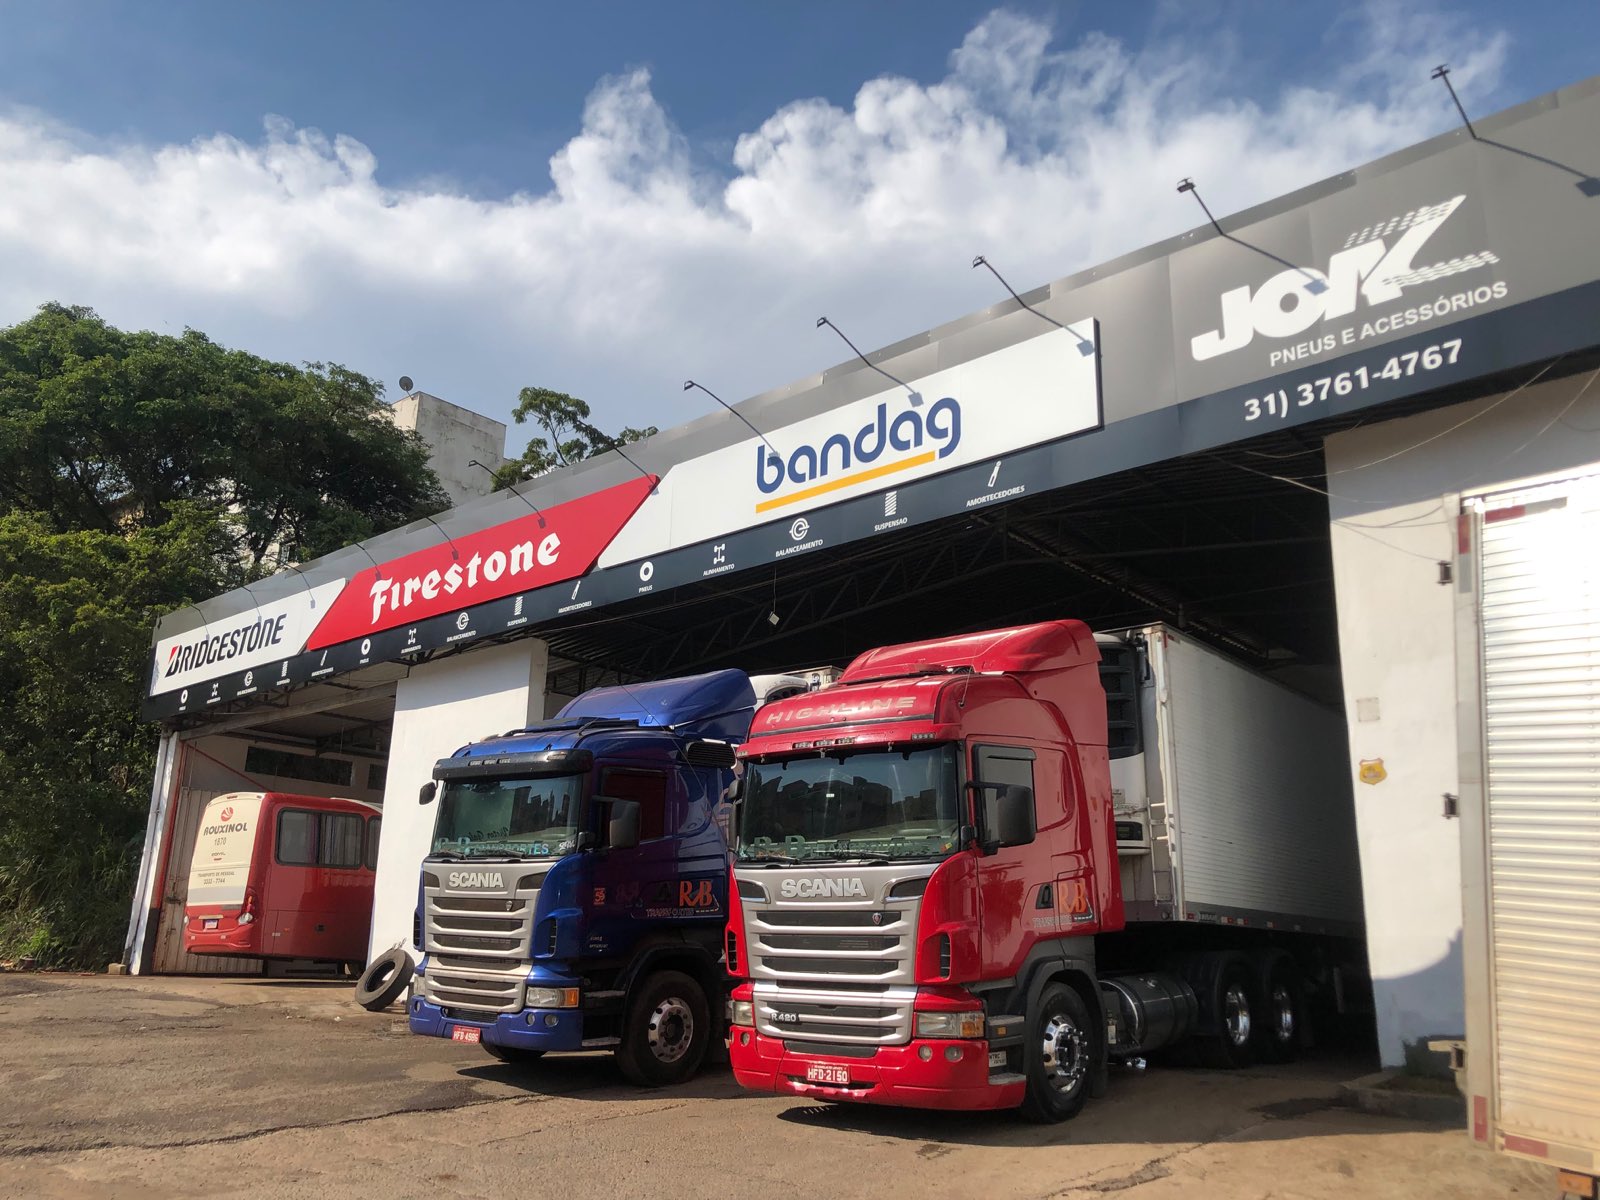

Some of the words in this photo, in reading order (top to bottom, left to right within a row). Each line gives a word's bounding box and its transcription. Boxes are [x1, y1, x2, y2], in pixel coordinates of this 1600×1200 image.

[1269, 333, 1336, 367] PNEUS
[1341, 327, 1356, 346] E
[1360, 281, 1508, 340] ACESSÓRIOS
[1244, 390, 1289, 420] 31)
[1297, 338, 1463, 406] 3761-4767
[757, 397, 961, 494] bandag
[966, 485, 1025, 508] AMORTECEDORES
[775, 539, 823, 558] BALANCEAMENTO
[369, 532, 561, 625] Firestone
[703, 563, 735, 577] ALINHAMENTO
[638, 584, 653, 593] PNEUS
[165, 613, 287, 678] BRIDGESTONE
[766, 696, 917, 724] HIGHLINE
[203, 822, 248, 836] ROUXINOL
[449, 871, 504, 888] SCANIA
[781, 877, 867, 898] SCANIA
